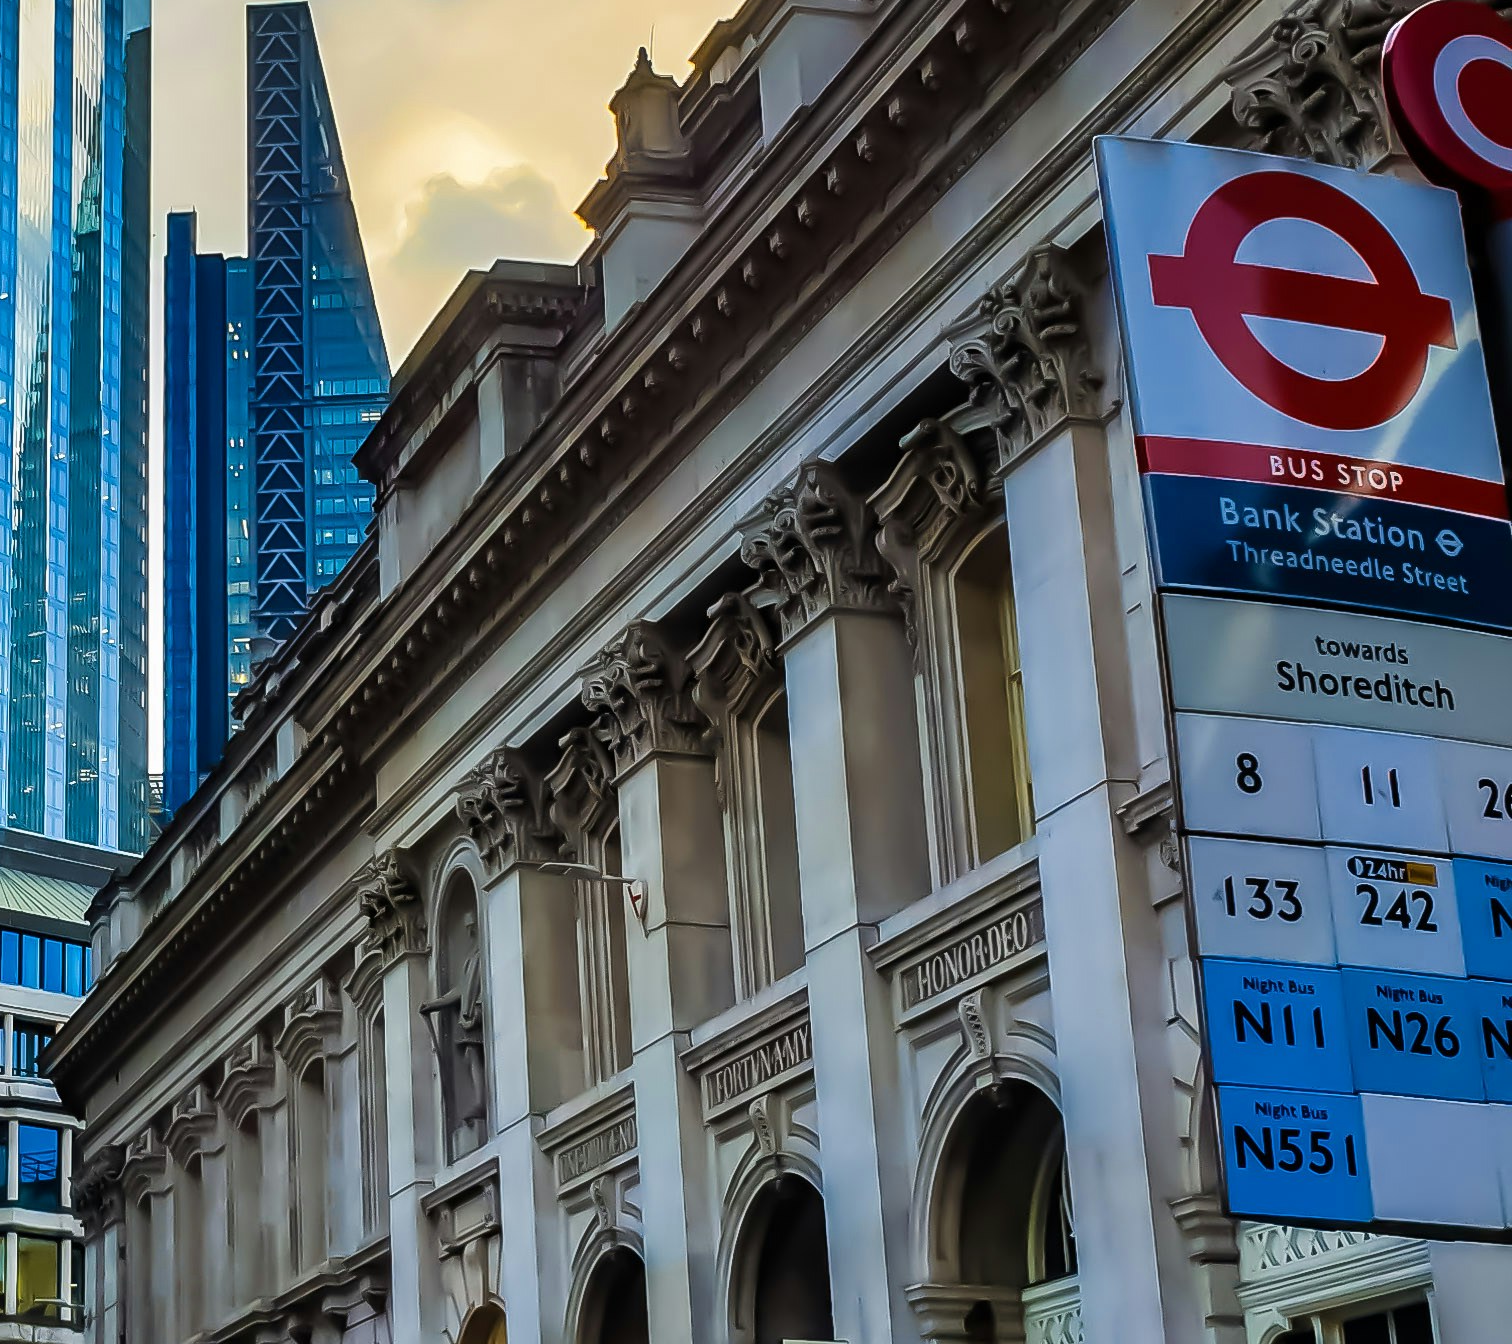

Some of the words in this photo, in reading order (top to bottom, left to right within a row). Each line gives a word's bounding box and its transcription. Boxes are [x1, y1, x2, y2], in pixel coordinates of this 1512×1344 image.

[1269, 455, 1324, 482] BUS
[1337, 463, 1404, 492] STOP
[1219, 496, 1303, 534] Bank
[1313, 506, 1426, 552] Station
[1226, 539, 1395, 582] Threadneedle
[1403, 562, 1470, 595] Street
[1314, 635, 1409, 665] towards
[1276, 660, 1455, 711] Shoreditch
[1236, 752, 1263, 794] 8
[1361, 764, 1402, 808] 11
[1223, 874, 1303, 923] 133
[1355, 883, 1438, 933] 242
[1242, 975, 1285, 995] Night
[1288, 980, 1316, 996] Bus
[1376, 984, 1416, 1003] Night
[1419, 989, 1444, 1005] Bus
[1233, 999, 1326, 1049] N11
[1367, 1007, 1461, 1058] N26
[1254, 1101, 1298, 1120] Night
[1301, 1104, 1329, 1121] Bus
[1233, 1123, 1358, 1178] N551
